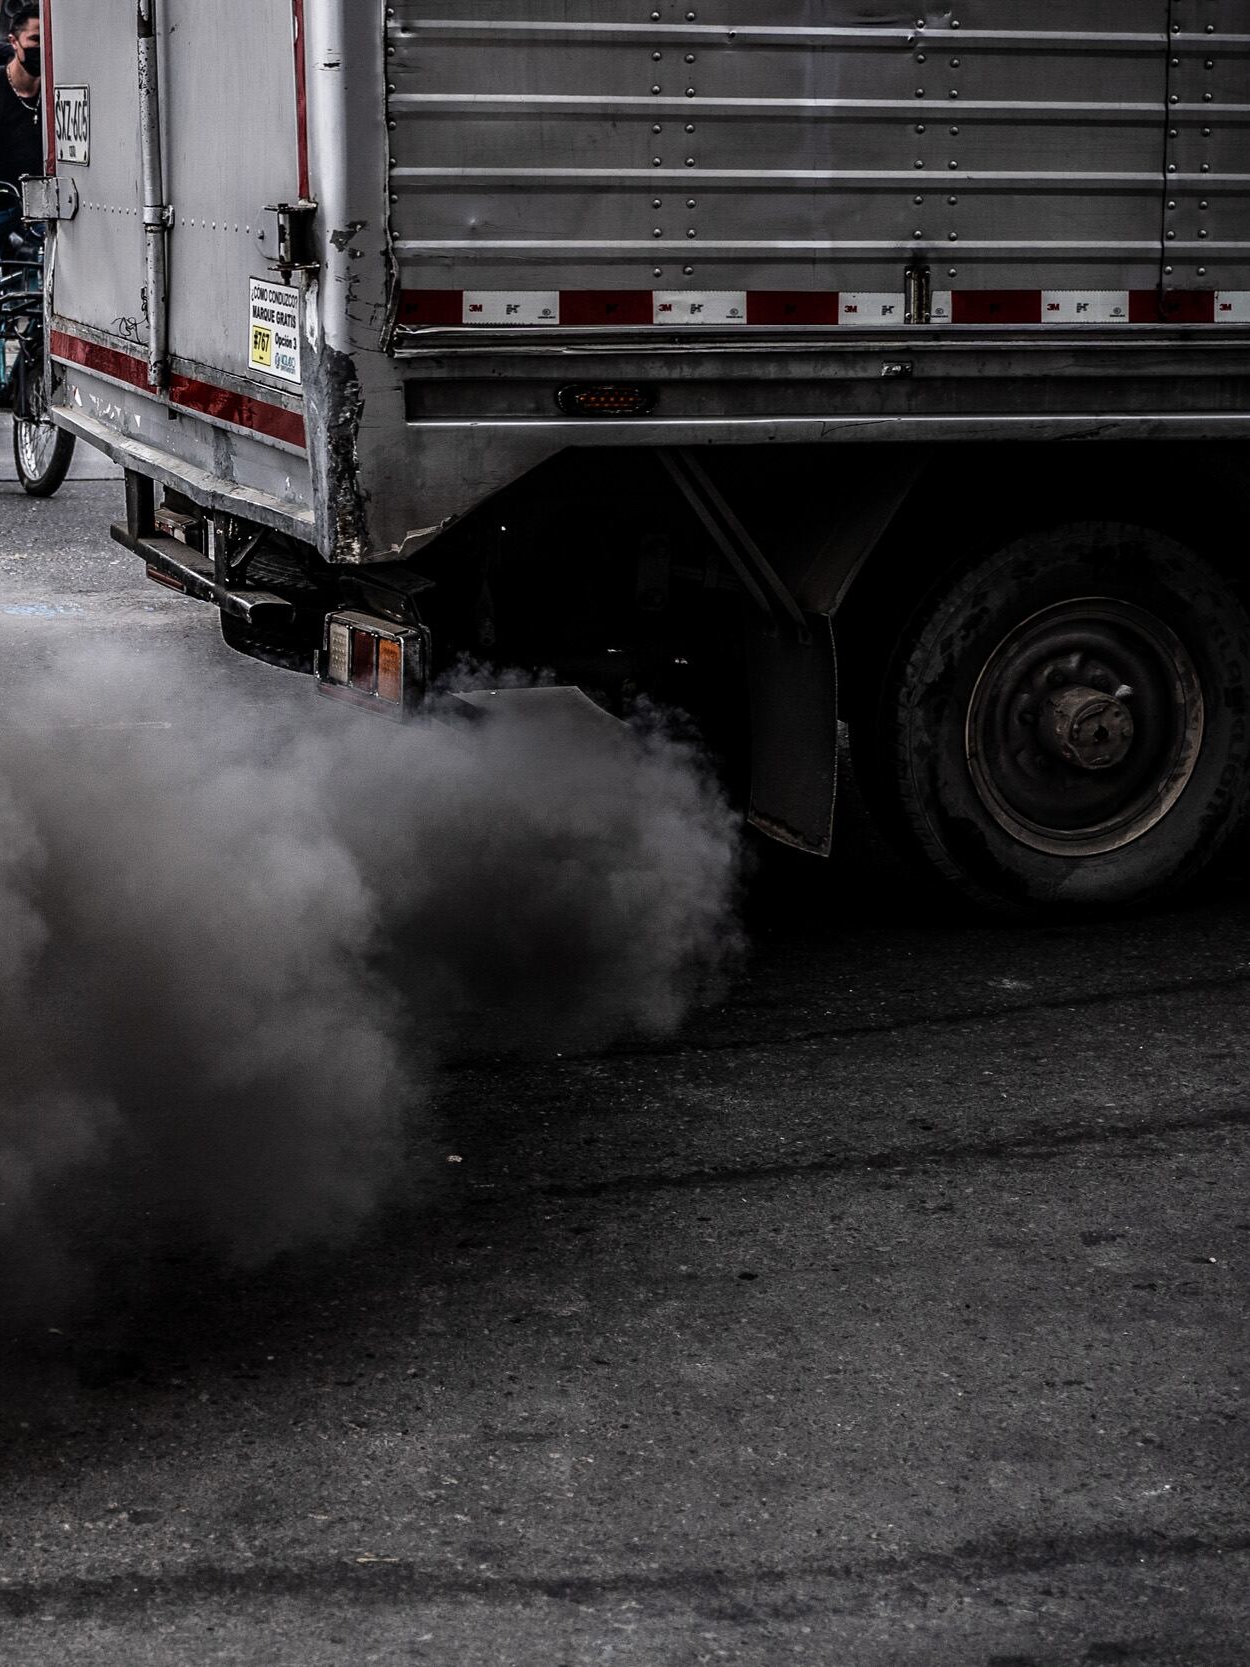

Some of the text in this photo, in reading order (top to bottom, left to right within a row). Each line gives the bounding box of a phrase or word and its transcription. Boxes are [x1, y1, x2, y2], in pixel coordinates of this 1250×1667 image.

[269, 290, 298, 309] CONDUZCO?
[469, 304, 483, 312] 3M
[658, 304, 672, 312] 3M
[844, 305, 857, 313] 3M
[1047, 303, 1060, 311] 3M
[1219, 303, 1232, 311] 3M
[252, 305, 296, 329] MARQUE GRATIS
[254, 330, 270, 352] #767
[275, 332, 292, 349] Opción
